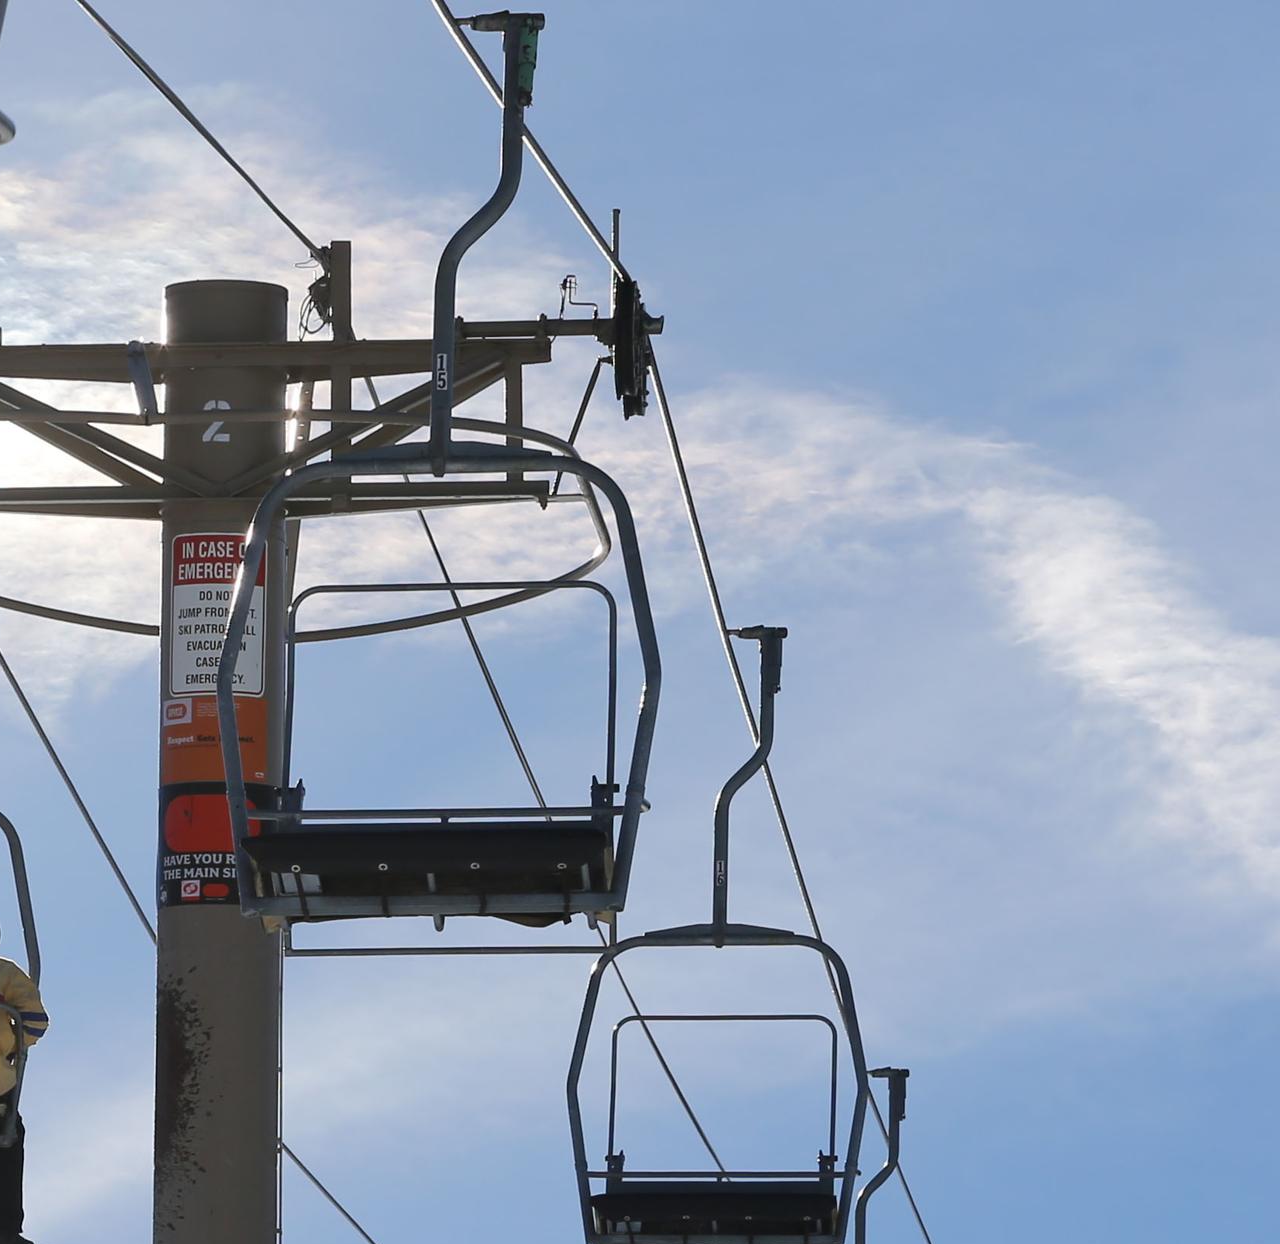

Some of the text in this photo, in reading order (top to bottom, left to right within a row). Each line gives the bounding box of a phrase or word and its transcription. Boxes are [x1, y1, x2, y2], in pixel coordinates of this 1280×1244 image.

[437, 354, 447, 389] 15
[202, 400, 231, 442] 2
[182, 542, 195, 559] IN
[199, 541, 234, 558] CASE
[199, 591, 213, 601] DO
[178, 608, 202, 619] JUMP
[178, 625, 192, 635] SKI
[195, 657, 220, 667] CASE
[185, 674, 246, 684] EMERGCY.
[163, 854, 191, 867] HAVE
[193, 853, 222, 865] YOU
[163, 869, 181, 881] THE
[183, 868, 220, 878] MAIN
